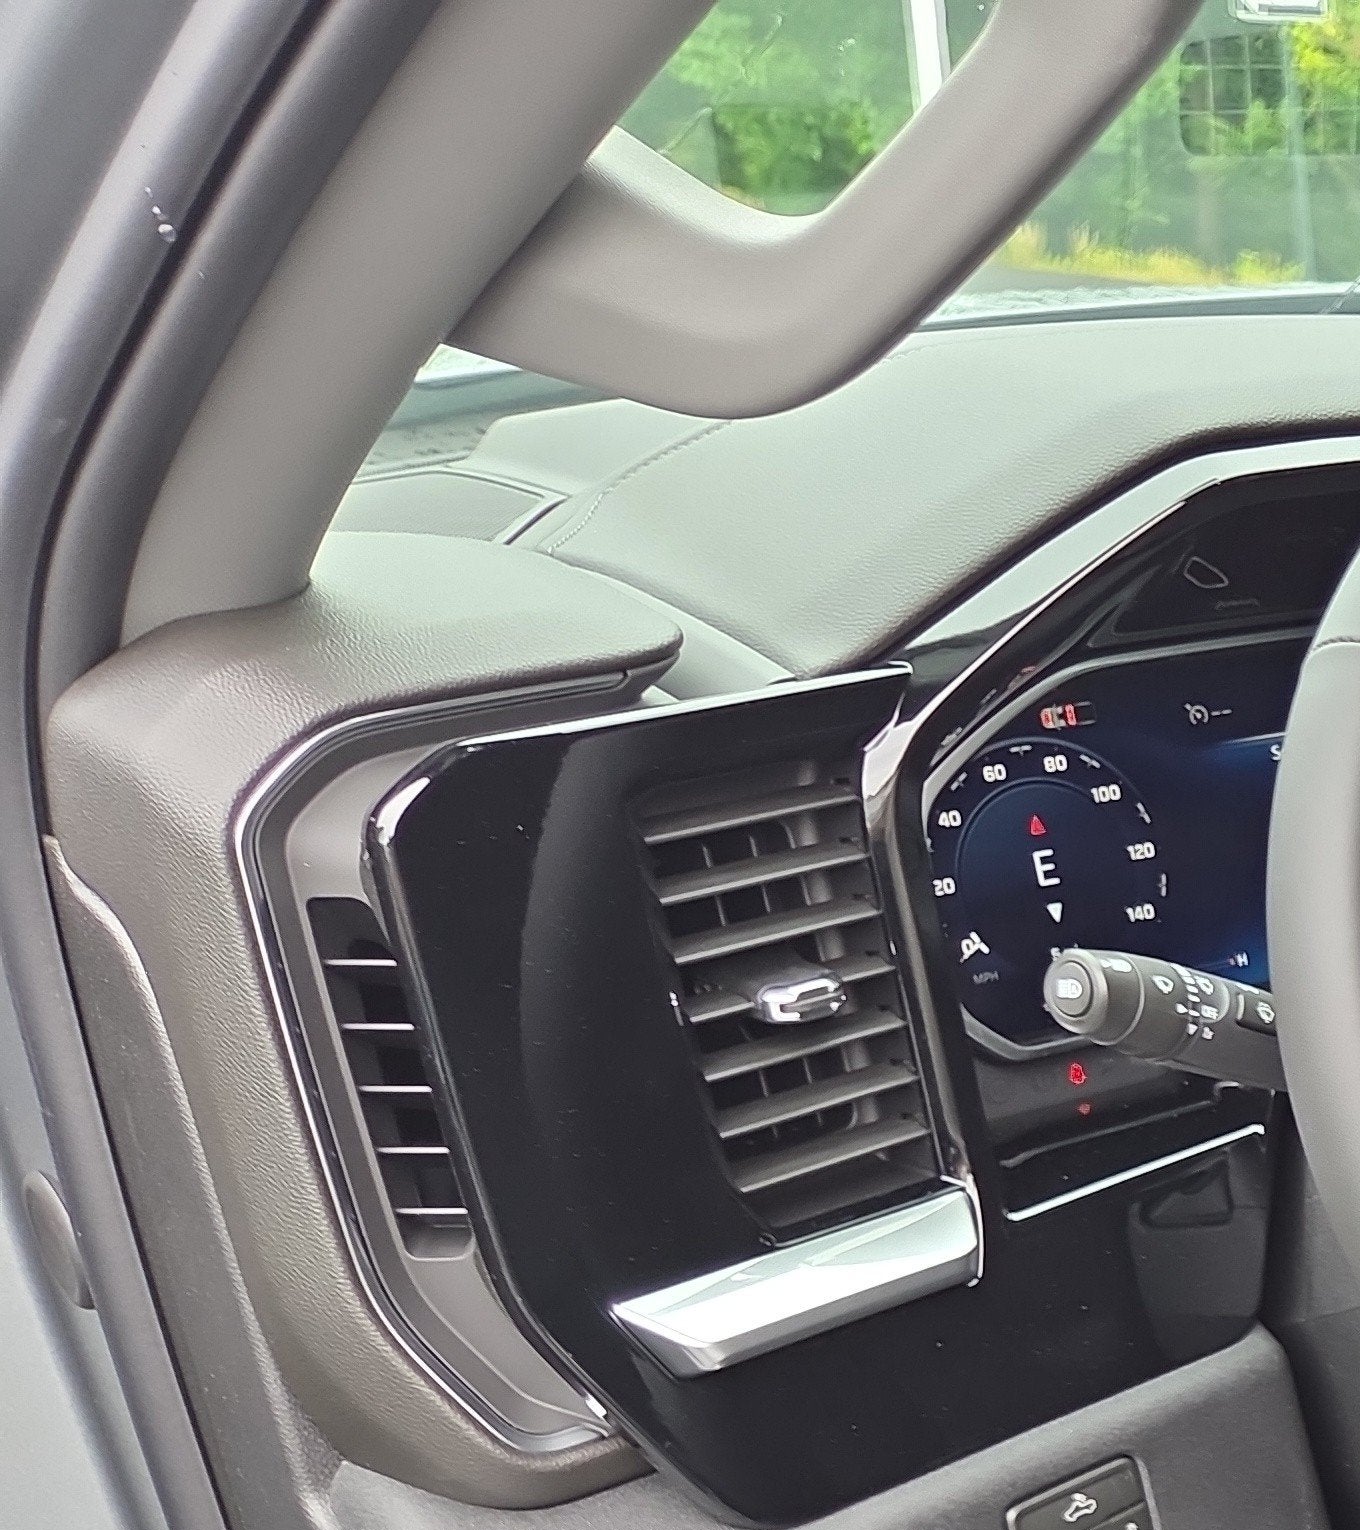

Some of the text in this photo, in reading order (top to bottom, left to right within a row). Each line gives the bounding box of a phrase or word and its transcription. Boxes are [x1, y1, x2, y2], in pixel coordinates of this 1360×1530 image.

[1043, 754, 1068, 773] 80
[982, 764, 1007, 783] 60
[1090, 784, 1122, 804] 100
[938, 810, 962, 828] 40
[1127, 842, 1156, 861] 120
[1032, 848, 1061, 887] E
[932, 877, 956, 897] 20
[1126, 903, 1156, 923] 140
